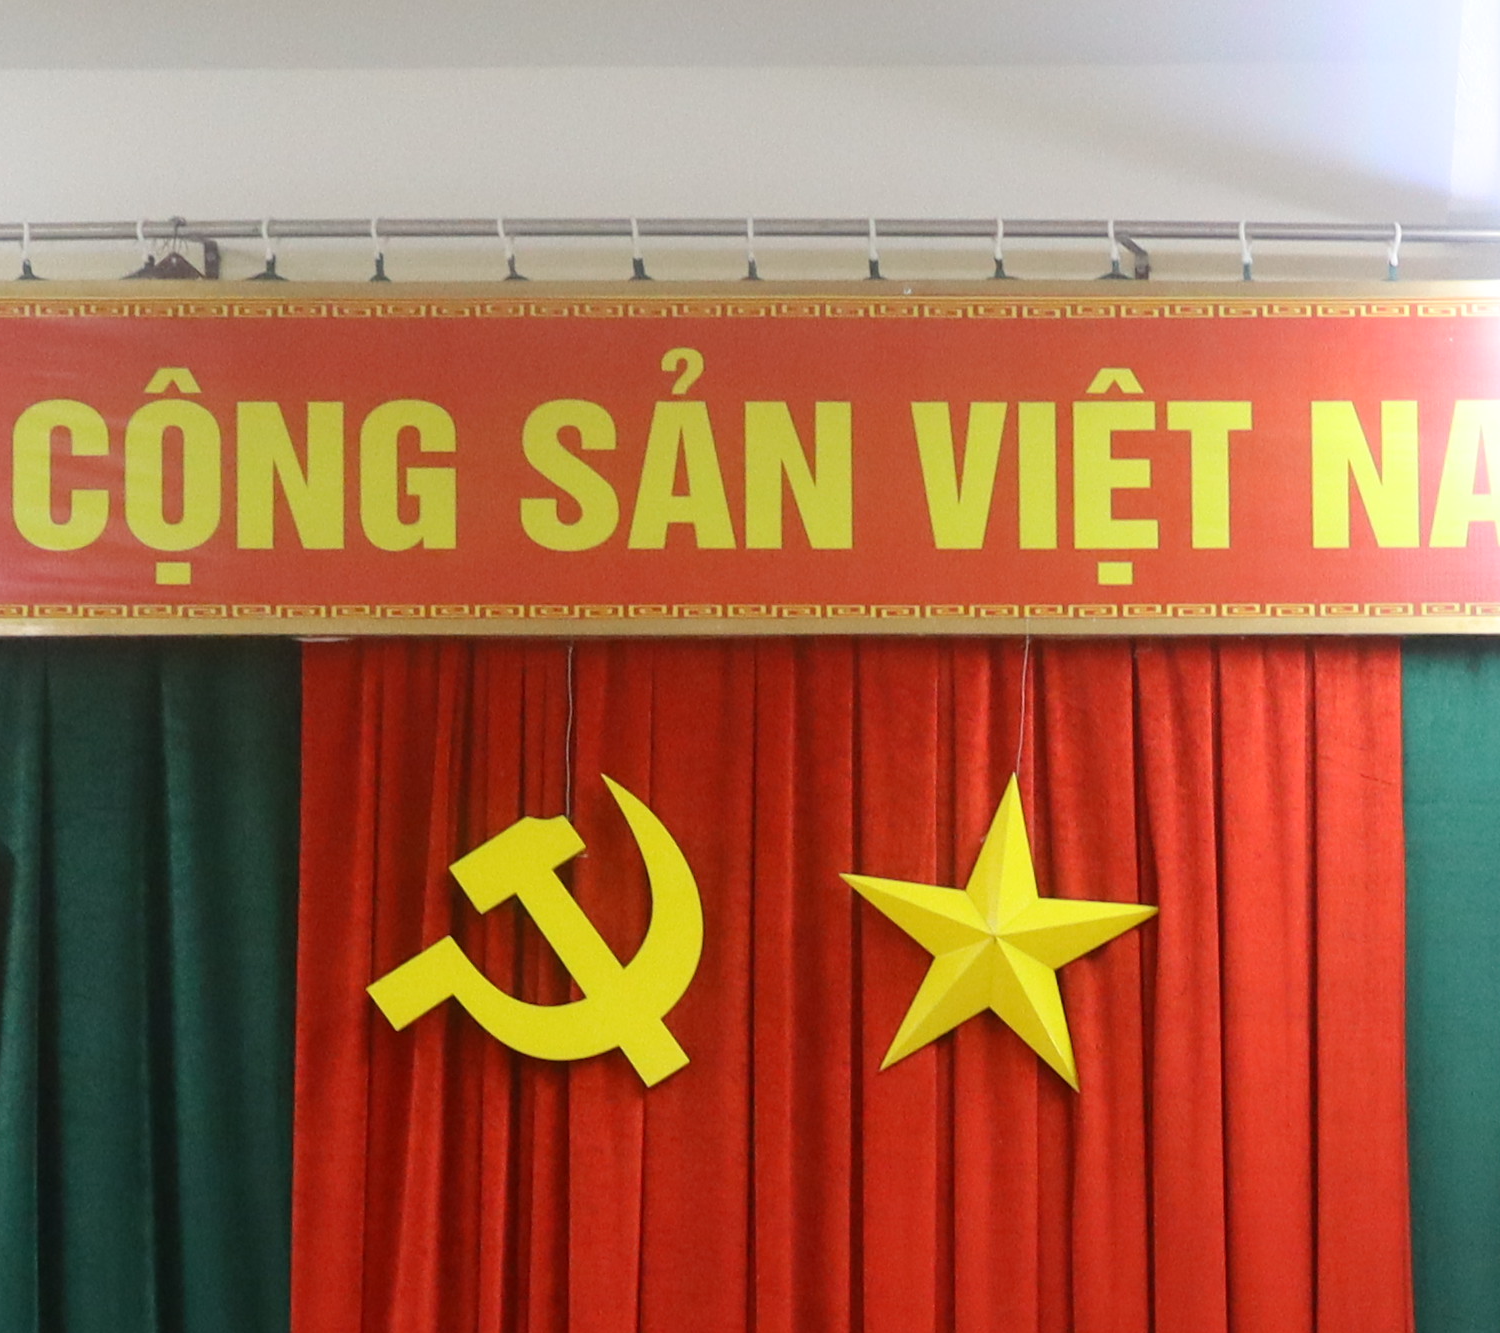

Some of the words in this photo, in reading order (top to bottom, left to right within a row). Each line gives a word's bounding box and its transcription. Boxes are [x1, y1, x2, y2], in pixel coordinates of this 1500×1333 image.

[11, 367, 457, 585] CỘNG
[520, 347, 853, 552] SẢN
[911, 367, 1254, 586] VIỆT
